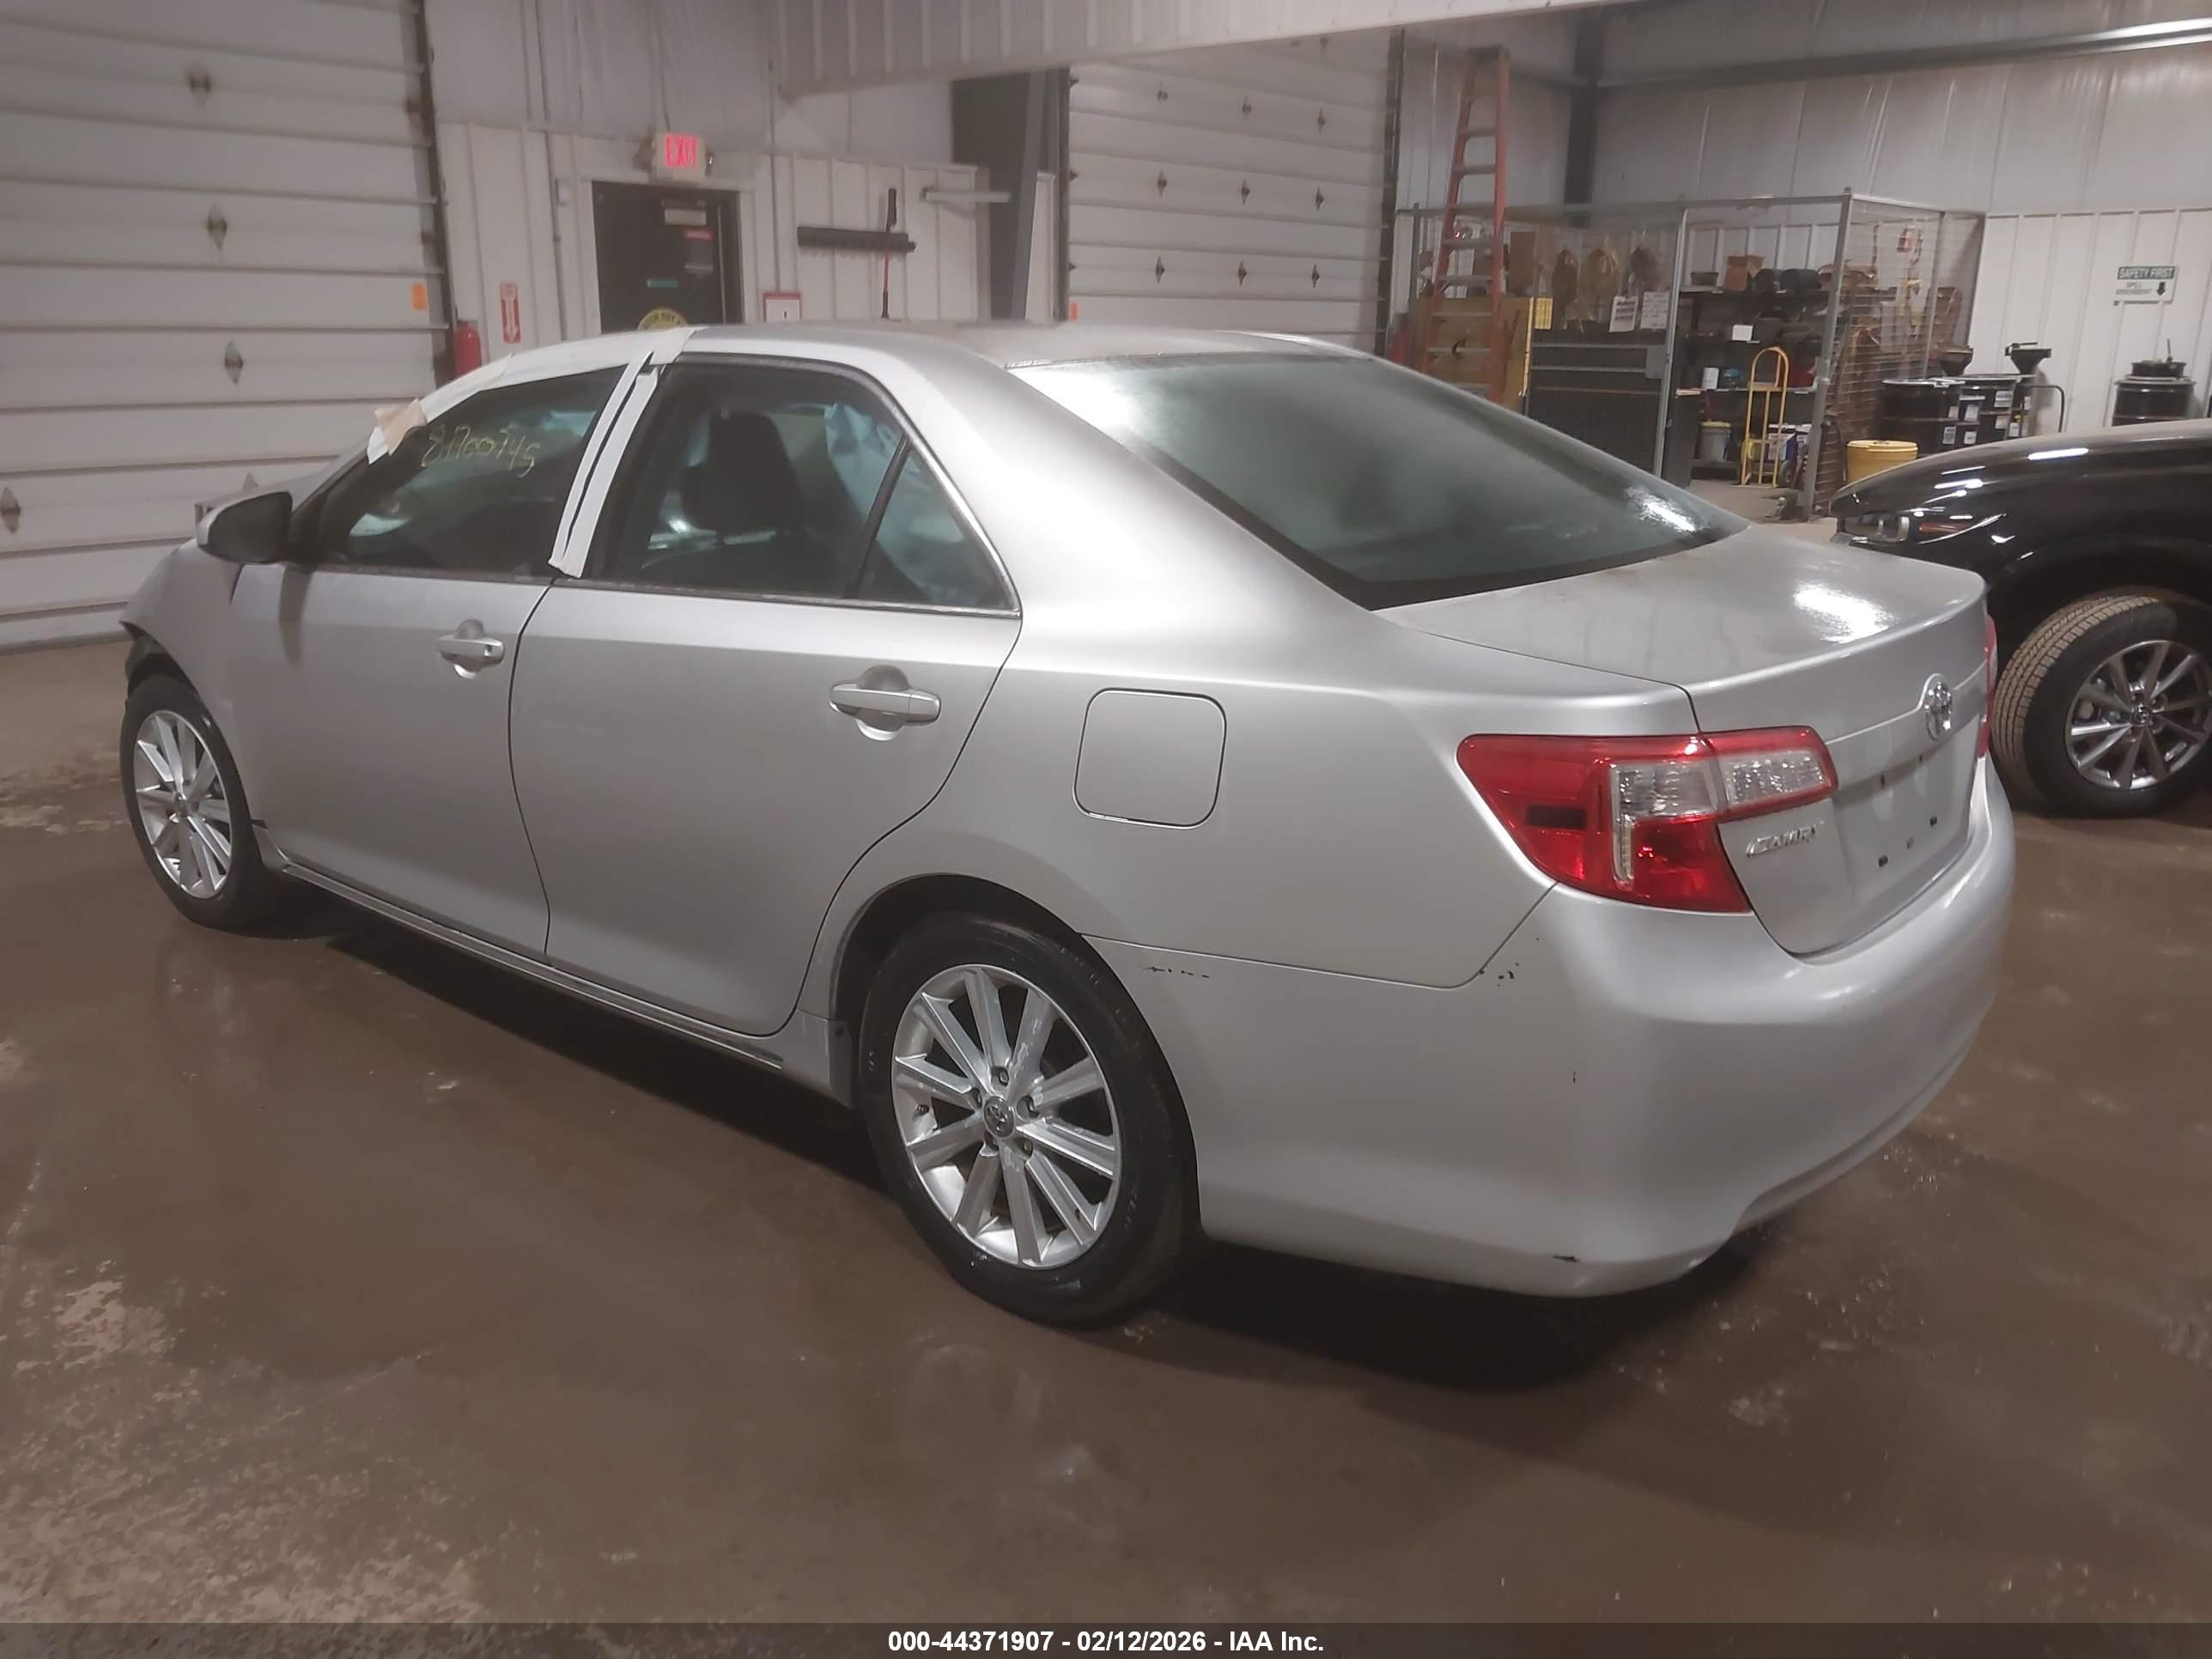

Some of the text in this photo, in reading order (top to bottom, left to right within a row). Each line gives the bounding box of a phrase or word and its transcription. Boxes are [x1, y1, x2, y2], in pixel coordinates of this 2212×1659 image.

[665, 135, 697, 167] EXIT
[2118, 267, 2173, 279] SAFETY FIRST
[1746, 822, 1820, 858] CAMRY
